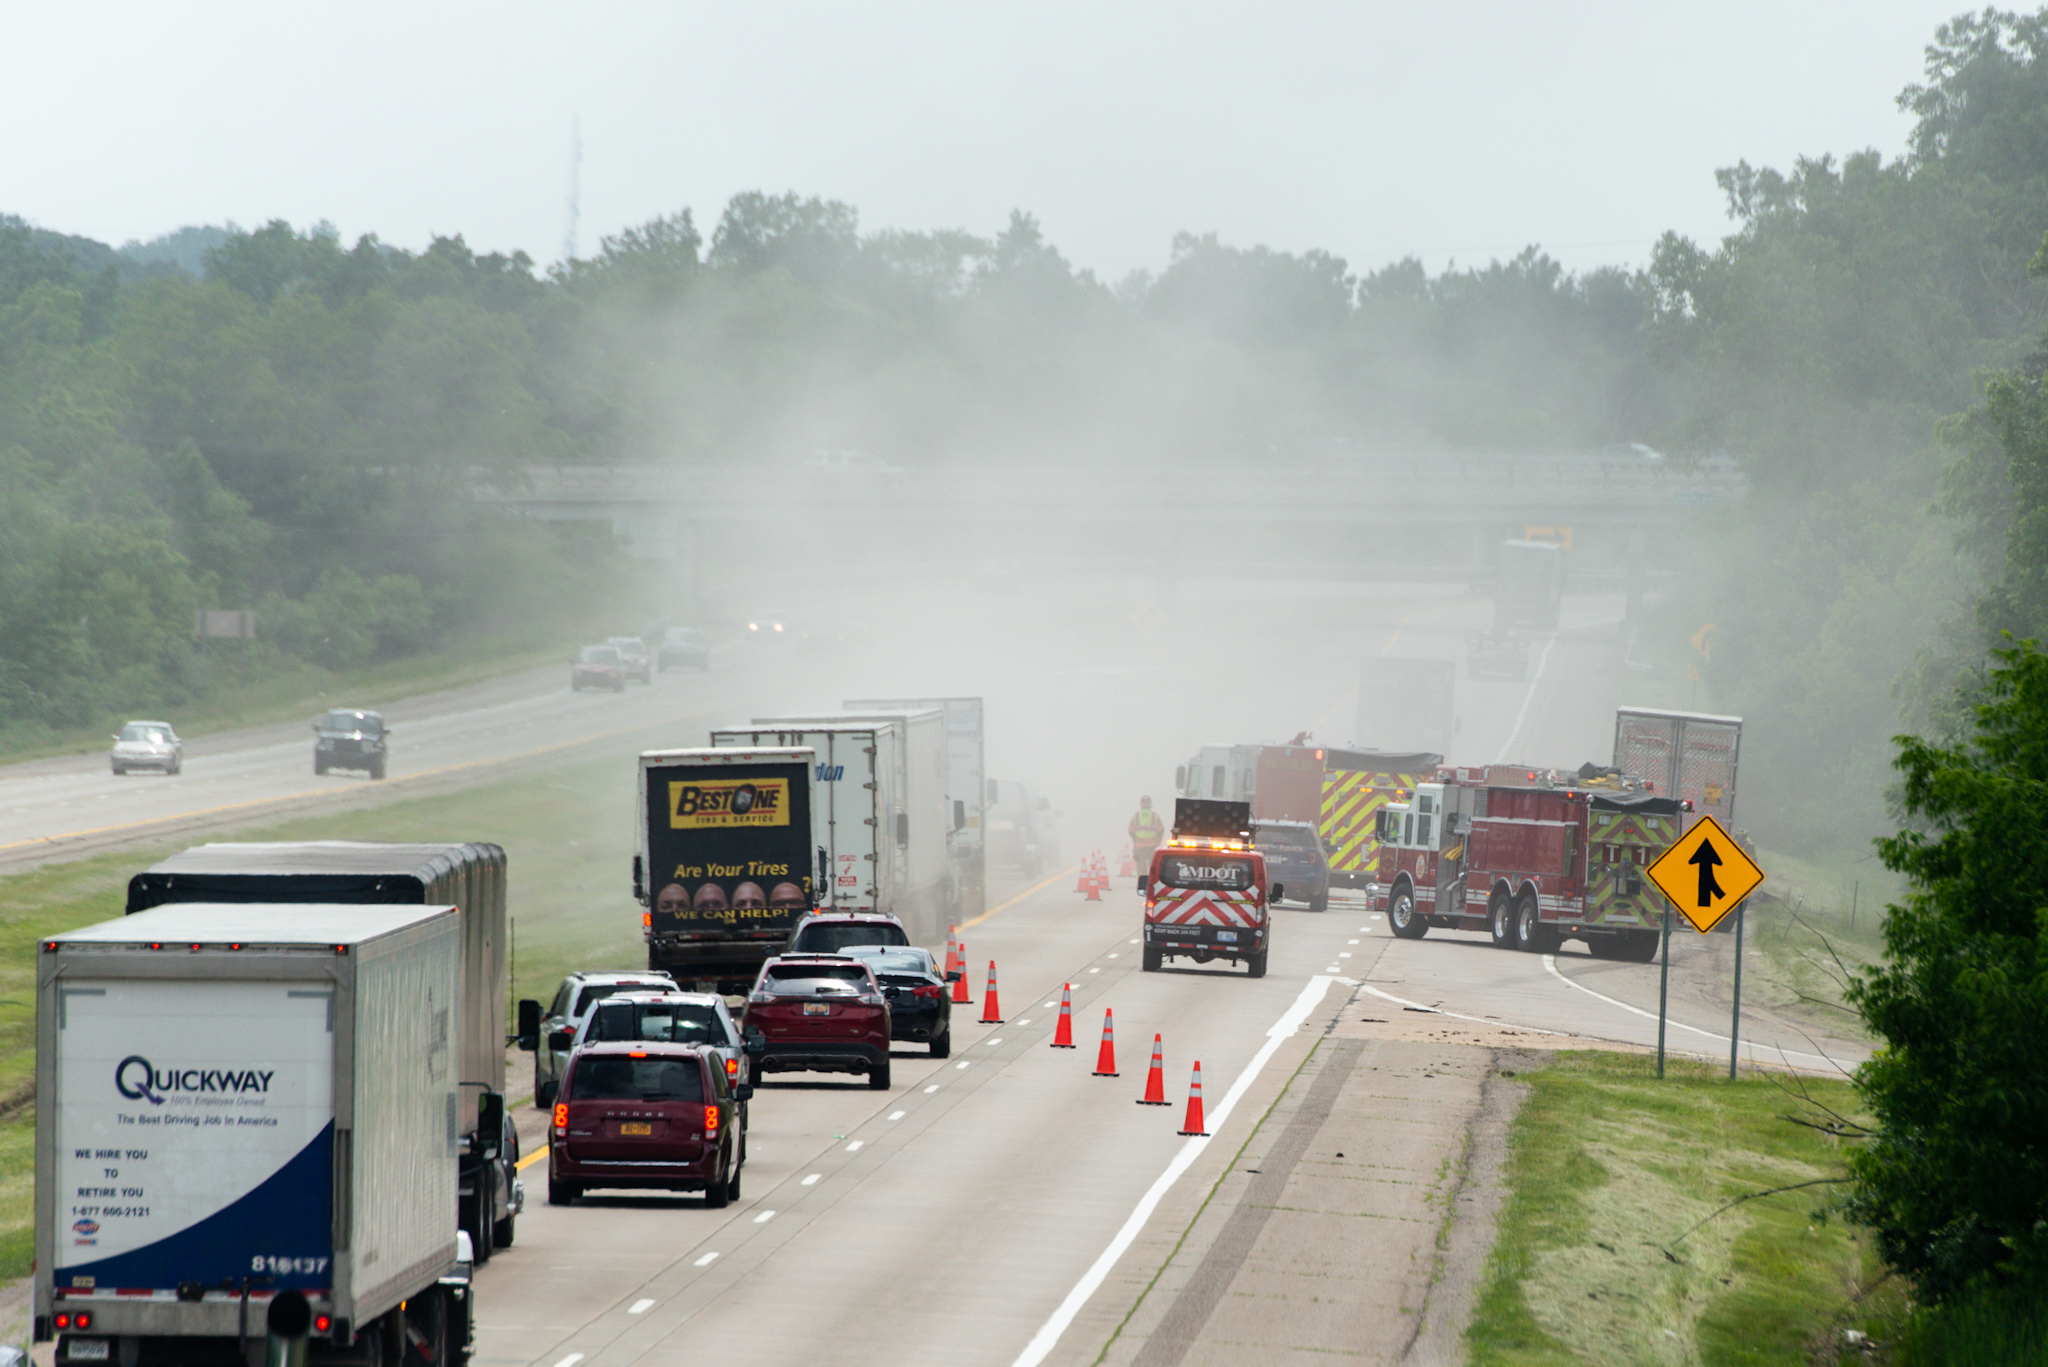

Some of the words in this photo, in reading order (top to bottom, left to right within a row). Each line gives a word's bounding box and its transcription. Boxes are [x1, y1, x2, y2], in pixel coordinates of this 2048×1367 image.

[695, 815, 717, 824] TIRE
[721, 815, 727, 823] &
[733, 814, 774, 823] SERVICE
[1606, 844, 1619, 862] T
[1637, 846, 1646, 864] 1
[674, 864, 702, 878] Are
[706, 863, 744, 877] Your
[747, 861, 789, 876] Tires
[1188, 866, 1240, 880] MDOT
[802, 876, 812, 893] ?
[674, 910, 698, 920] WE
[703, 910, 736, 919] CAN
[740, 909, 789, 918] HELP!
[115, 1055, 275, 1106] QUICKWAY
[194, 1096, 234, 1107] Employee
[236, 1096, 266, 1106] Owned
[117, 1114, 135, 1124] The
[138, 1114, 161, 1125] Best
[164, 1115, 200, 1127] Driving
[203, 1115, 221, 1126] Job
[224, 1115, 234, 1126] In
[237, 1116, 278, 1127] America
[75, 1149, 92, 1159] WE
[95, 1149, 121, 1160] HIRE
[125, 1149, 148, 1160] YOU
[104, 1168, 119, 1179] TO
[77, 1187, 117, 1198] RETIRE
[121, 1187, 144, 1198] YOU
